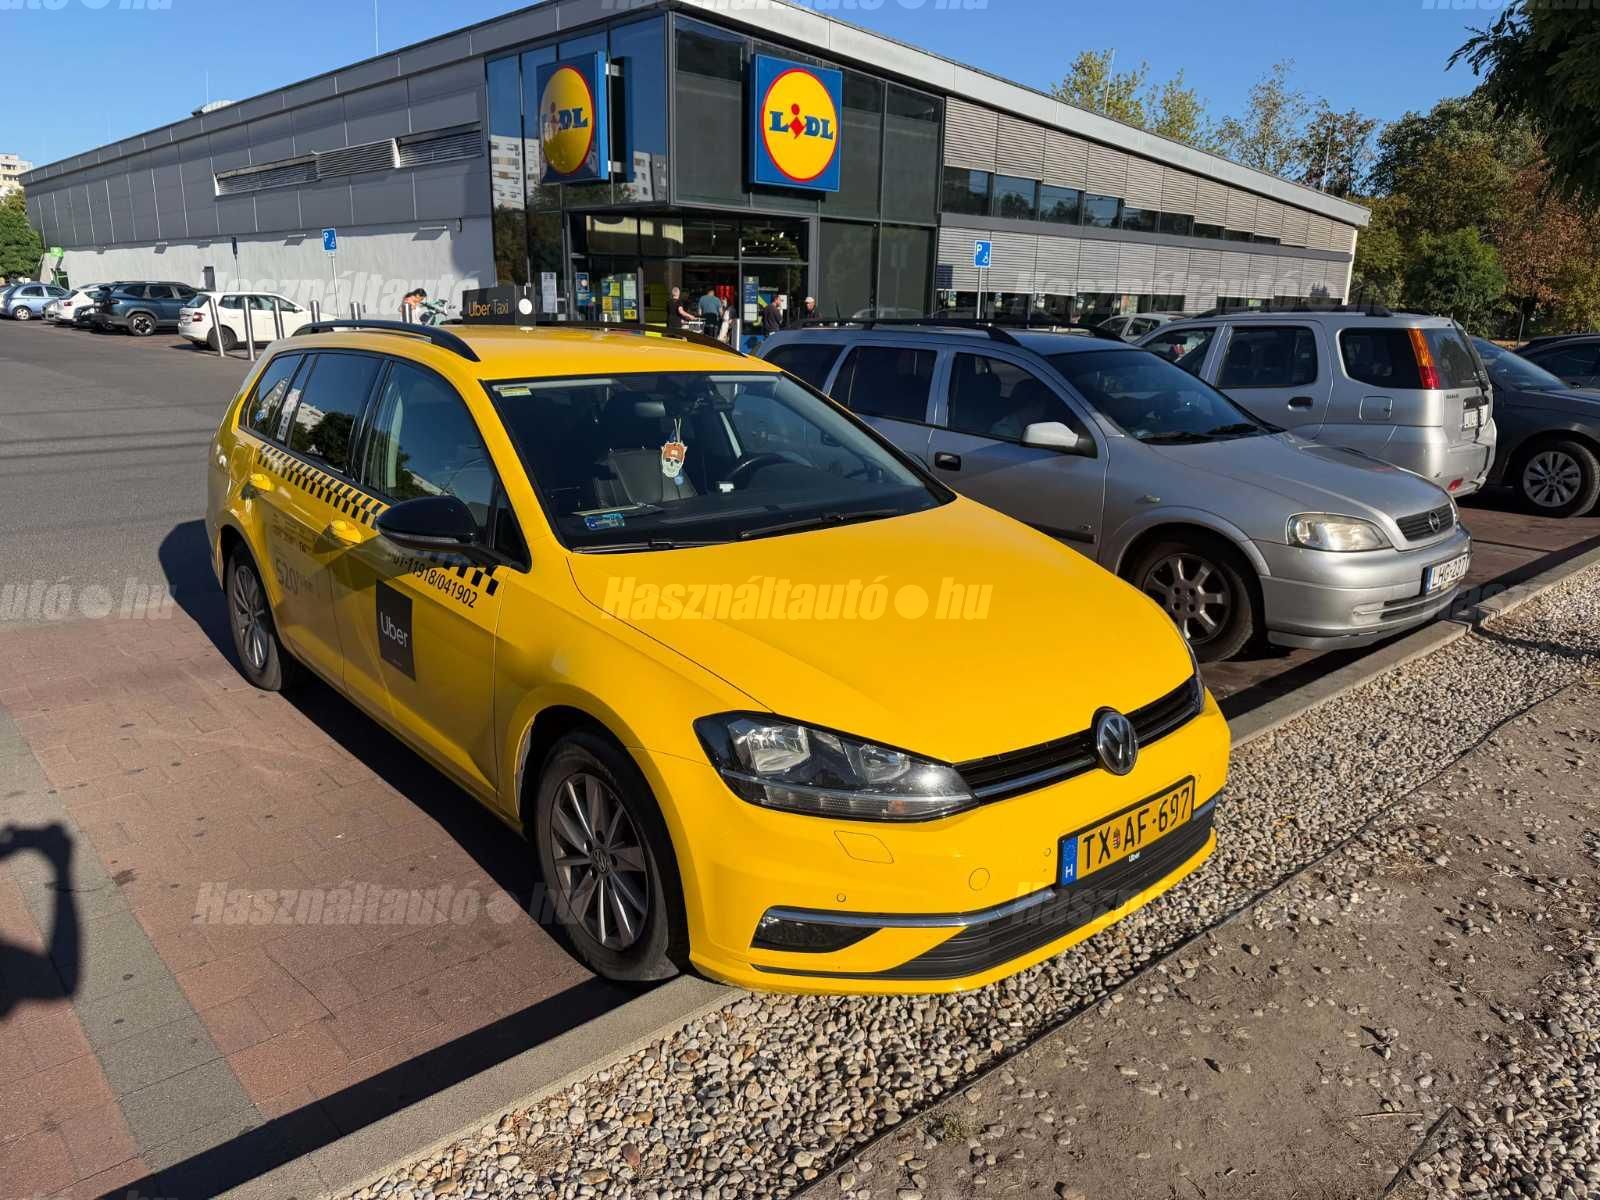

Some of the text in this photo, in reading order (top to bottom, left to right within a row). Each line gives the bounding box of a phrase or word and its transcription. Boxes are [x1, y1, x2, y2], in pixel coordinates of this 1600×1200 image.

[769, 103, 834, 140] LIDL
[468, 298, 510, 317] Uber Taxi
[380, 611, 409, 648] Uber
[1065, 863, 1073, 878] H
